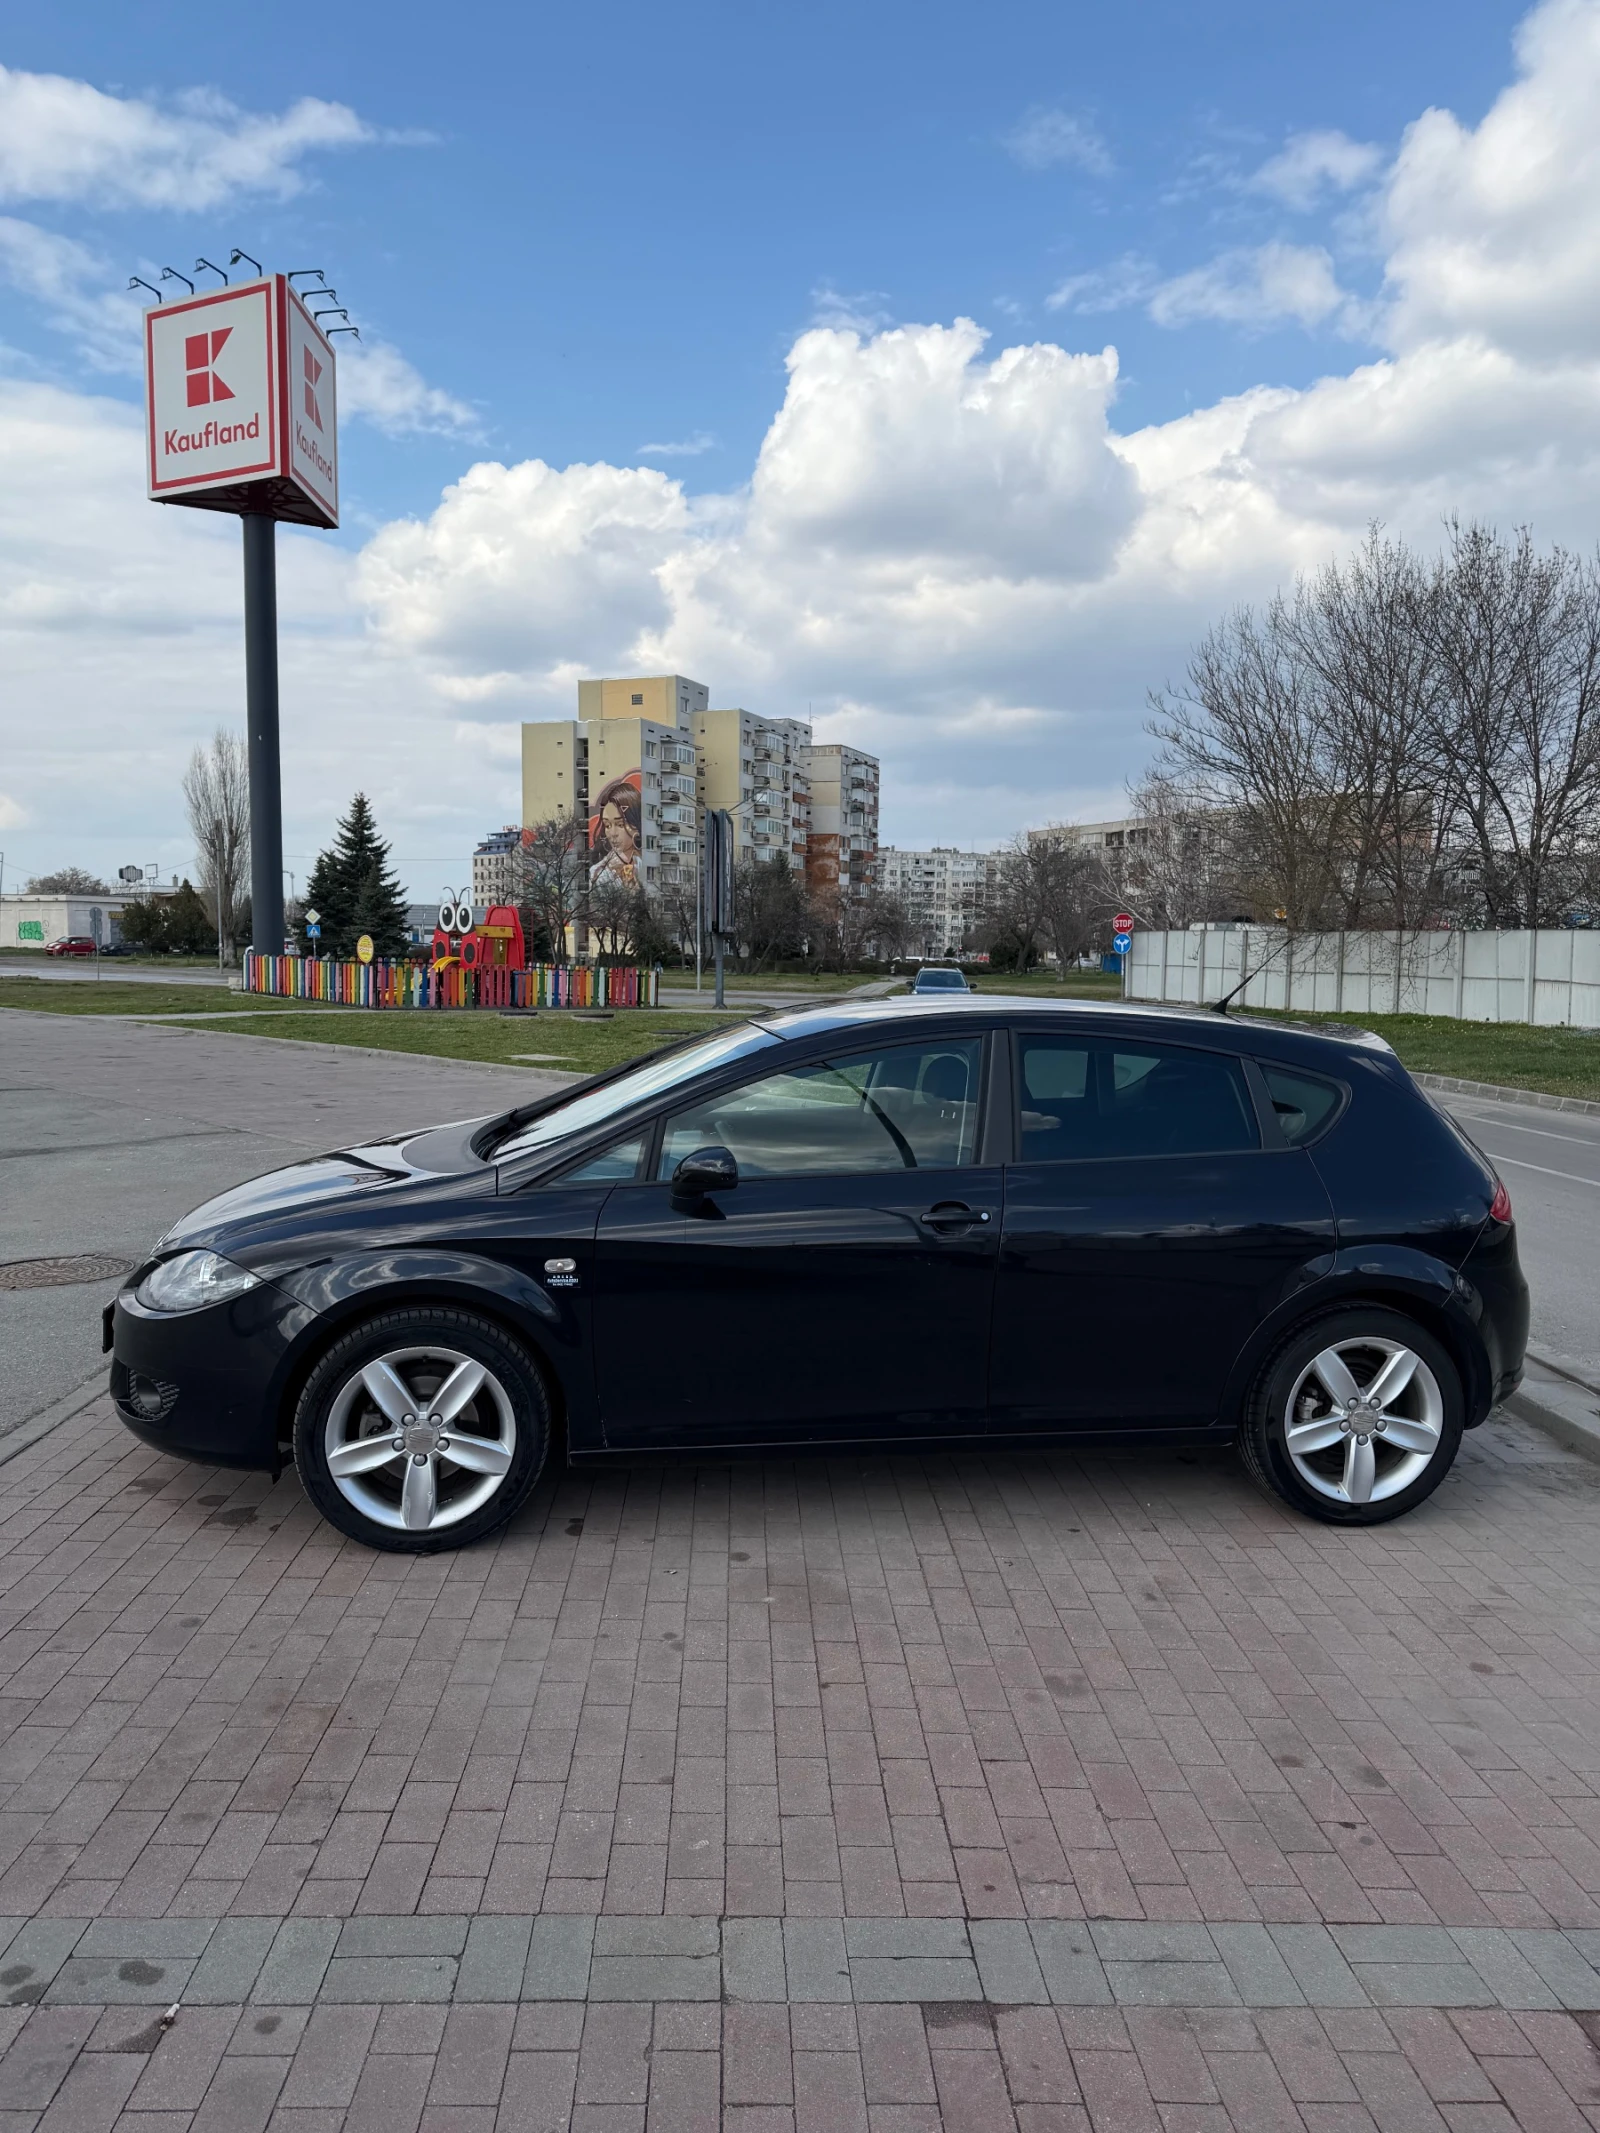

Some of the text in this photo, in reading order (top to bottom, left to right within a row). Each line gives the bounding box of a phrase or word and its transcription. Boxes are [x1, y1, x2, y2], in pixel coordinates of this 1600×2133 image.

[164, 412, 260, 455] Kaufland
[295, 420, 333, 482] Kaufland
[1114, 919, 1132, 928] STOP
